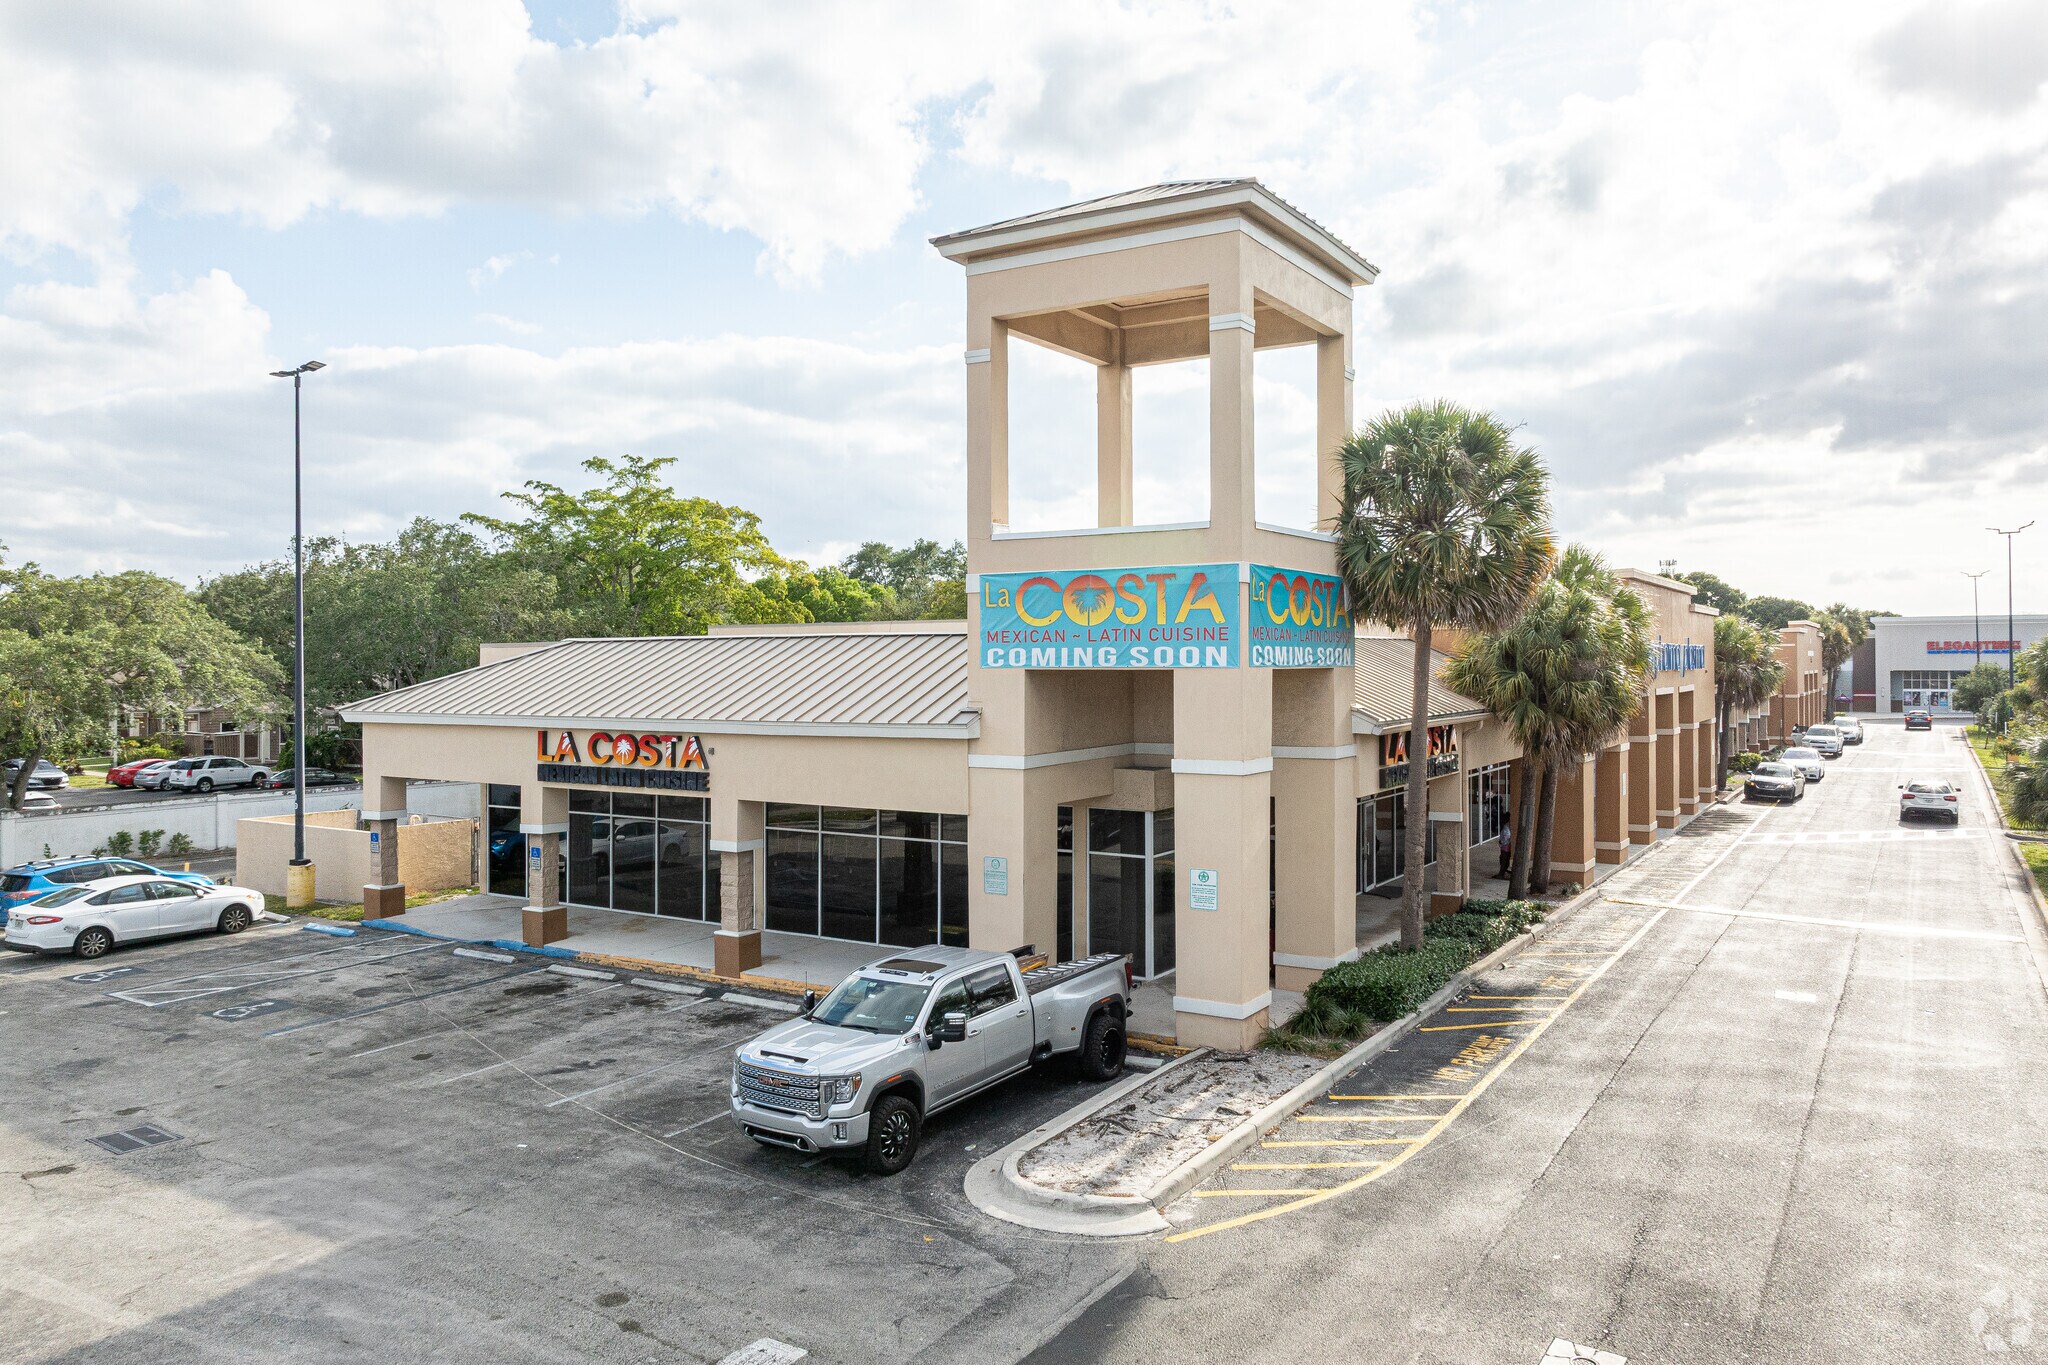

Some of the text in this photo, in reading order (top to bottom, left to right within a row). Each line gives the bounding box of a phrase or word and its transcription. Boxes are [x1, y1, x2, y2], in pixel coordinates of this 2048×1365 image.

[985, 572, 1226, 627] La COSTA
[1252, 572, 1351, 628] La COSTA
[986, 629, 1065, 644] MEXICAN
[1088, 628, 1141, 642] LATIN
[1149, 626, 1229, 642] CUISINE
[1252, 626, 1291, 641] MEXICAN
[1300, 629, 1322, 642] LATIN
[1323, 630, 1351, 643] CUISINE
[987, 645, 1228, 668] COMING SOON
[1252, 645, 1351, 666] COMING SOON
[537, 731, 710, 770] LA COSTA
[1380, 731, 1407, 767] LA
[645, 769, 710, 792] CUISINE
